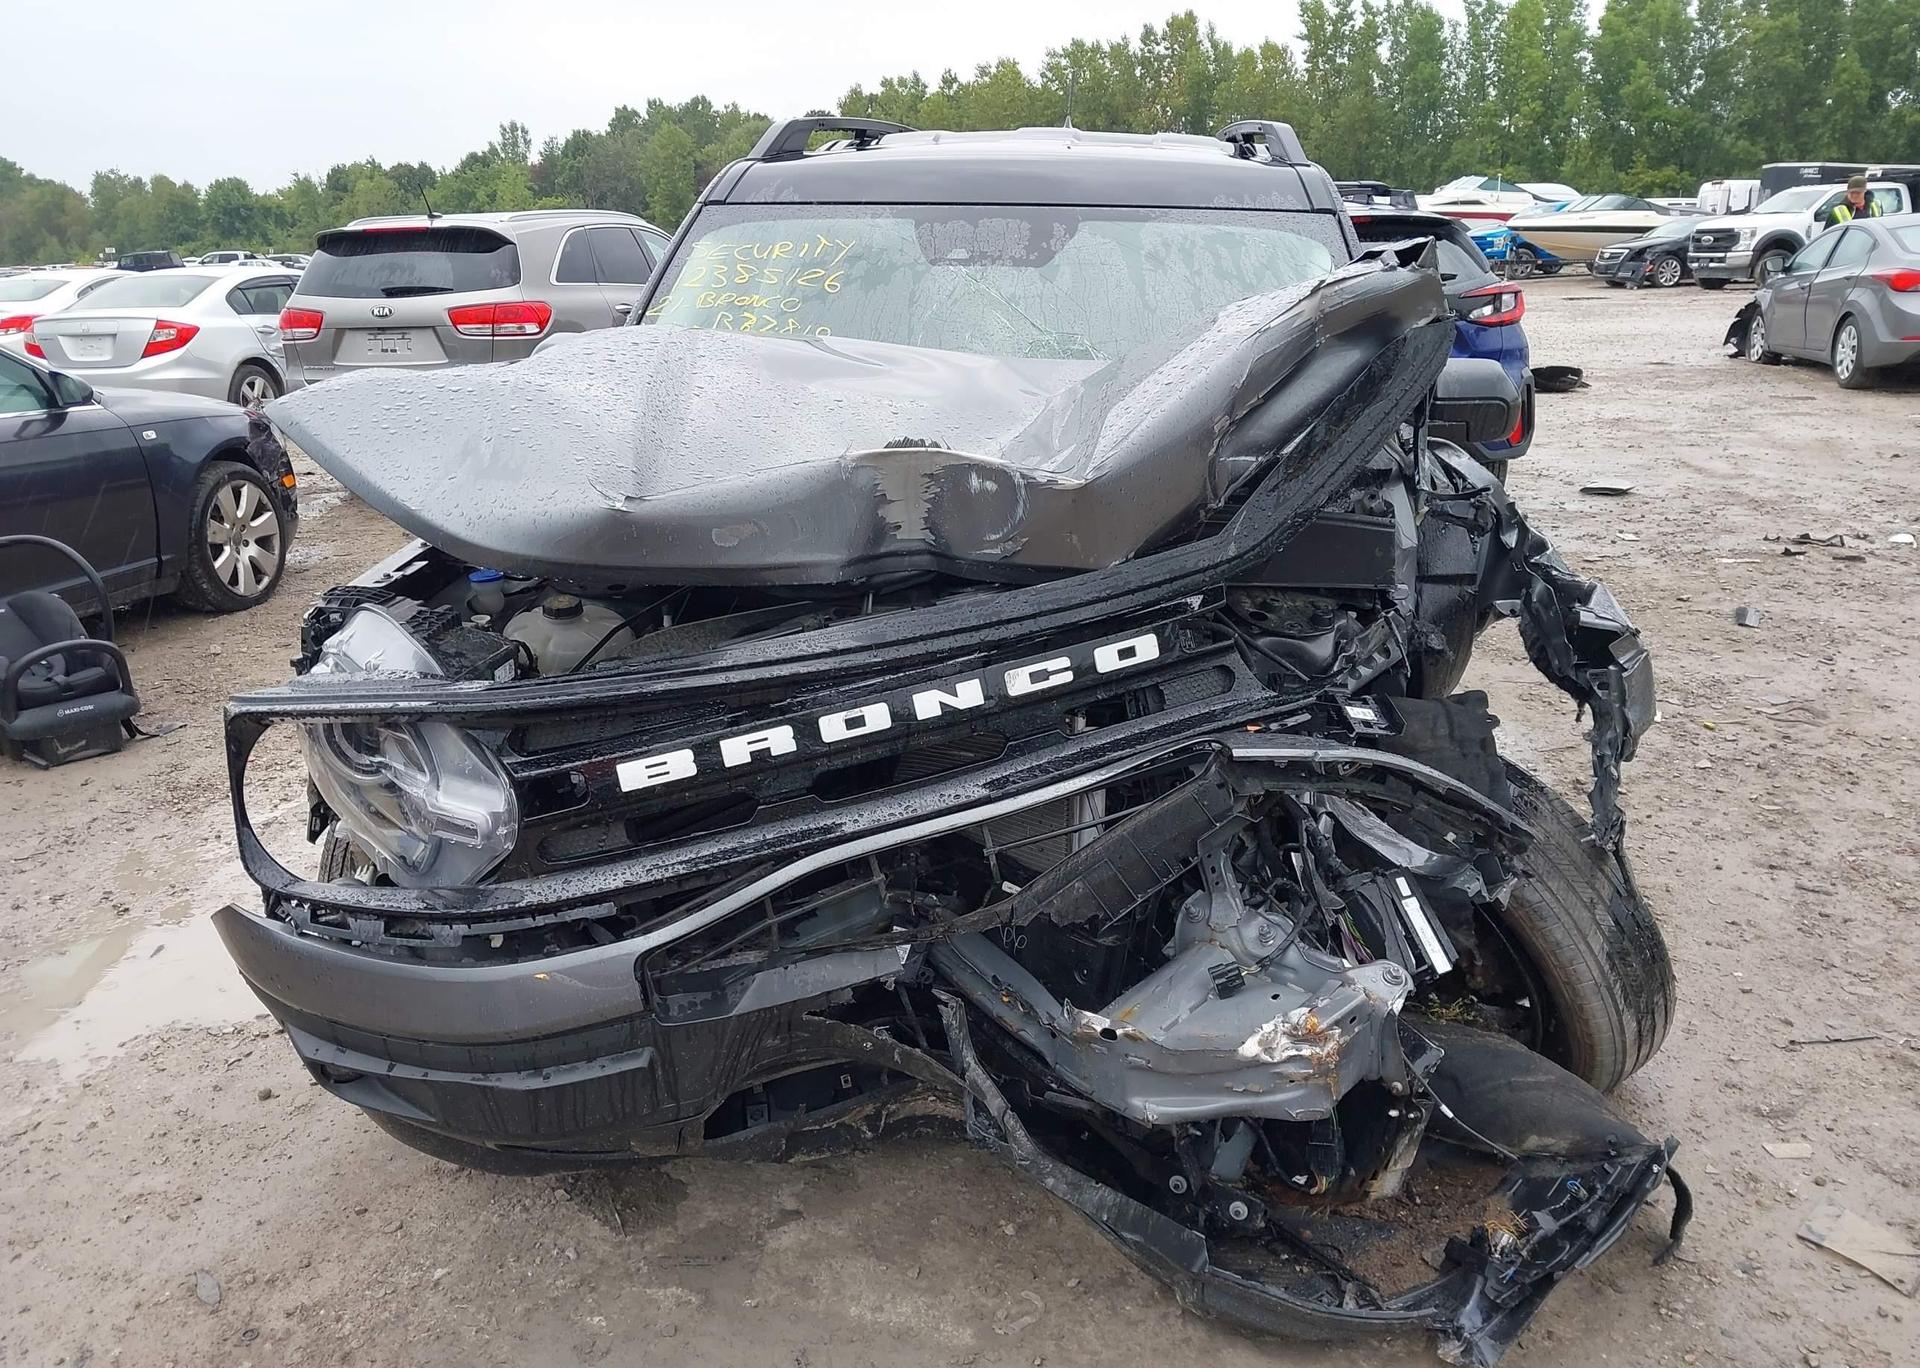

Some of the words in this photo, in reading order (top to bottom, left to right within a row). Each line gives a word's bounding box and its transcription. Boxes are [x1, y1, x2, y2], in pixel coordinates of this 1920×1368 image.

[692, 235, 856, 267] SECURITY
[683, 264, 845, 293] 2385126
[373, 307, 391, 316] KIA
[615, 632, 1161, 793] BRONCO
